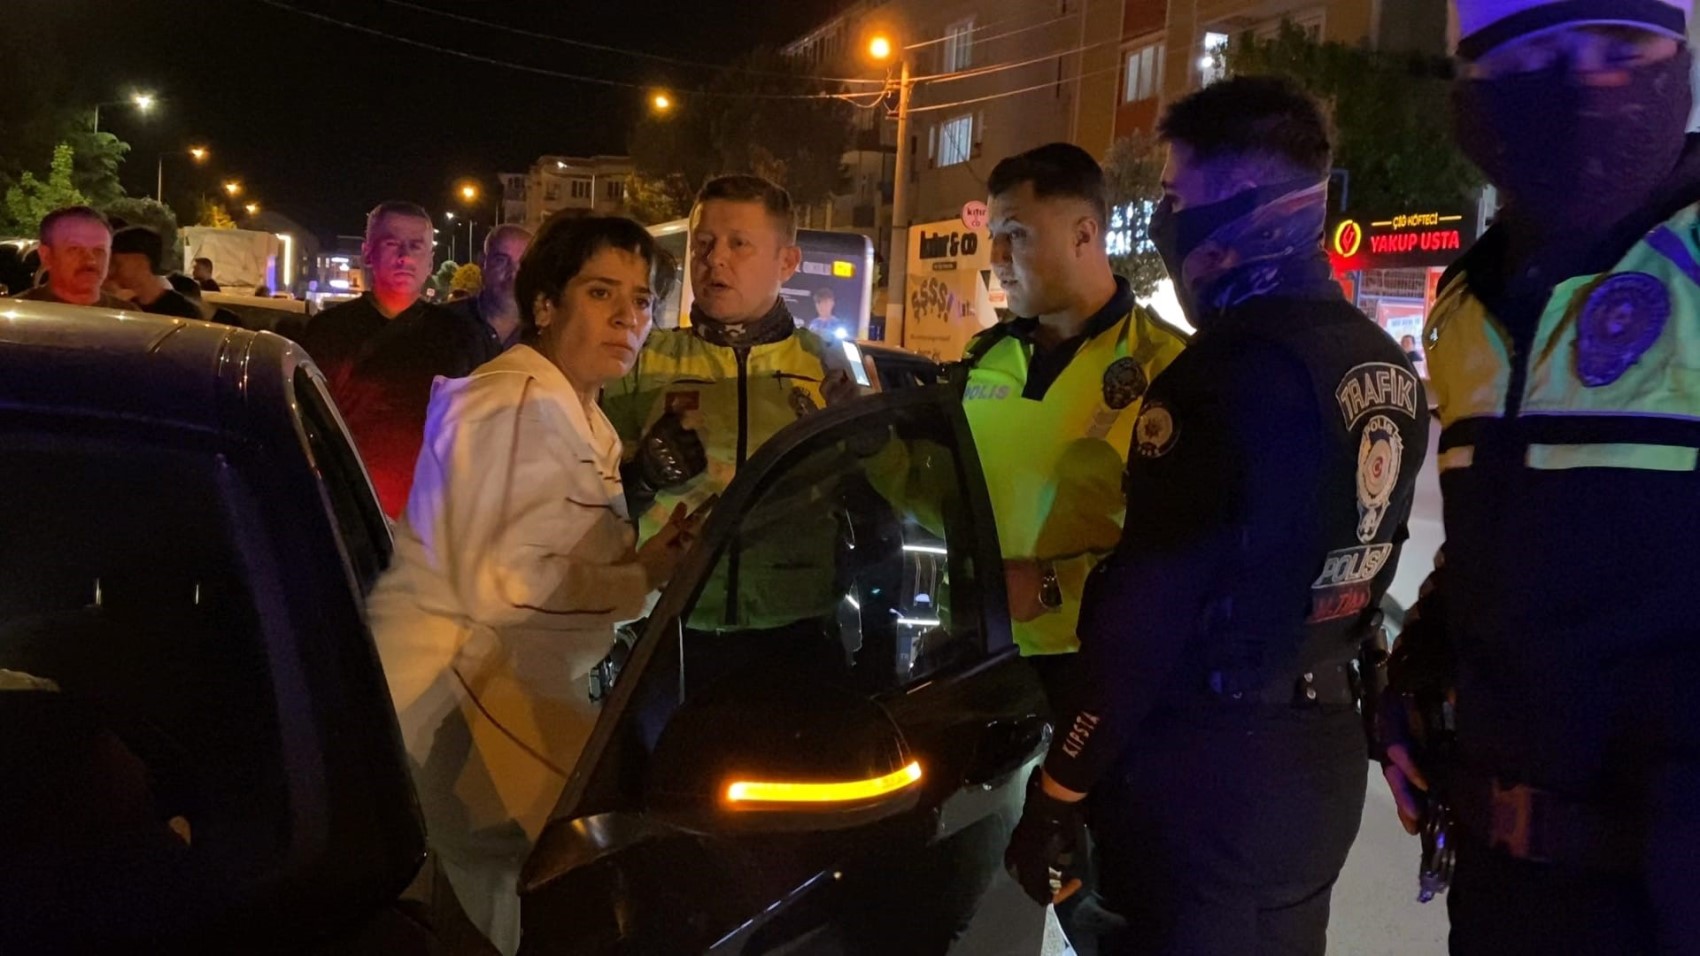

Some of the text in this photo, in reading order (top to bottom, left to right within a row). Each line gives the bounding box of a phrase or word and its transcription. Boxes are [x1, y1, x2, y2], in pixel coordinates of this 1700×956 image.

[1370, 230, 1460, 253] YAKUP USTA
[1062, 711, 1100, 758] KIPSTA
